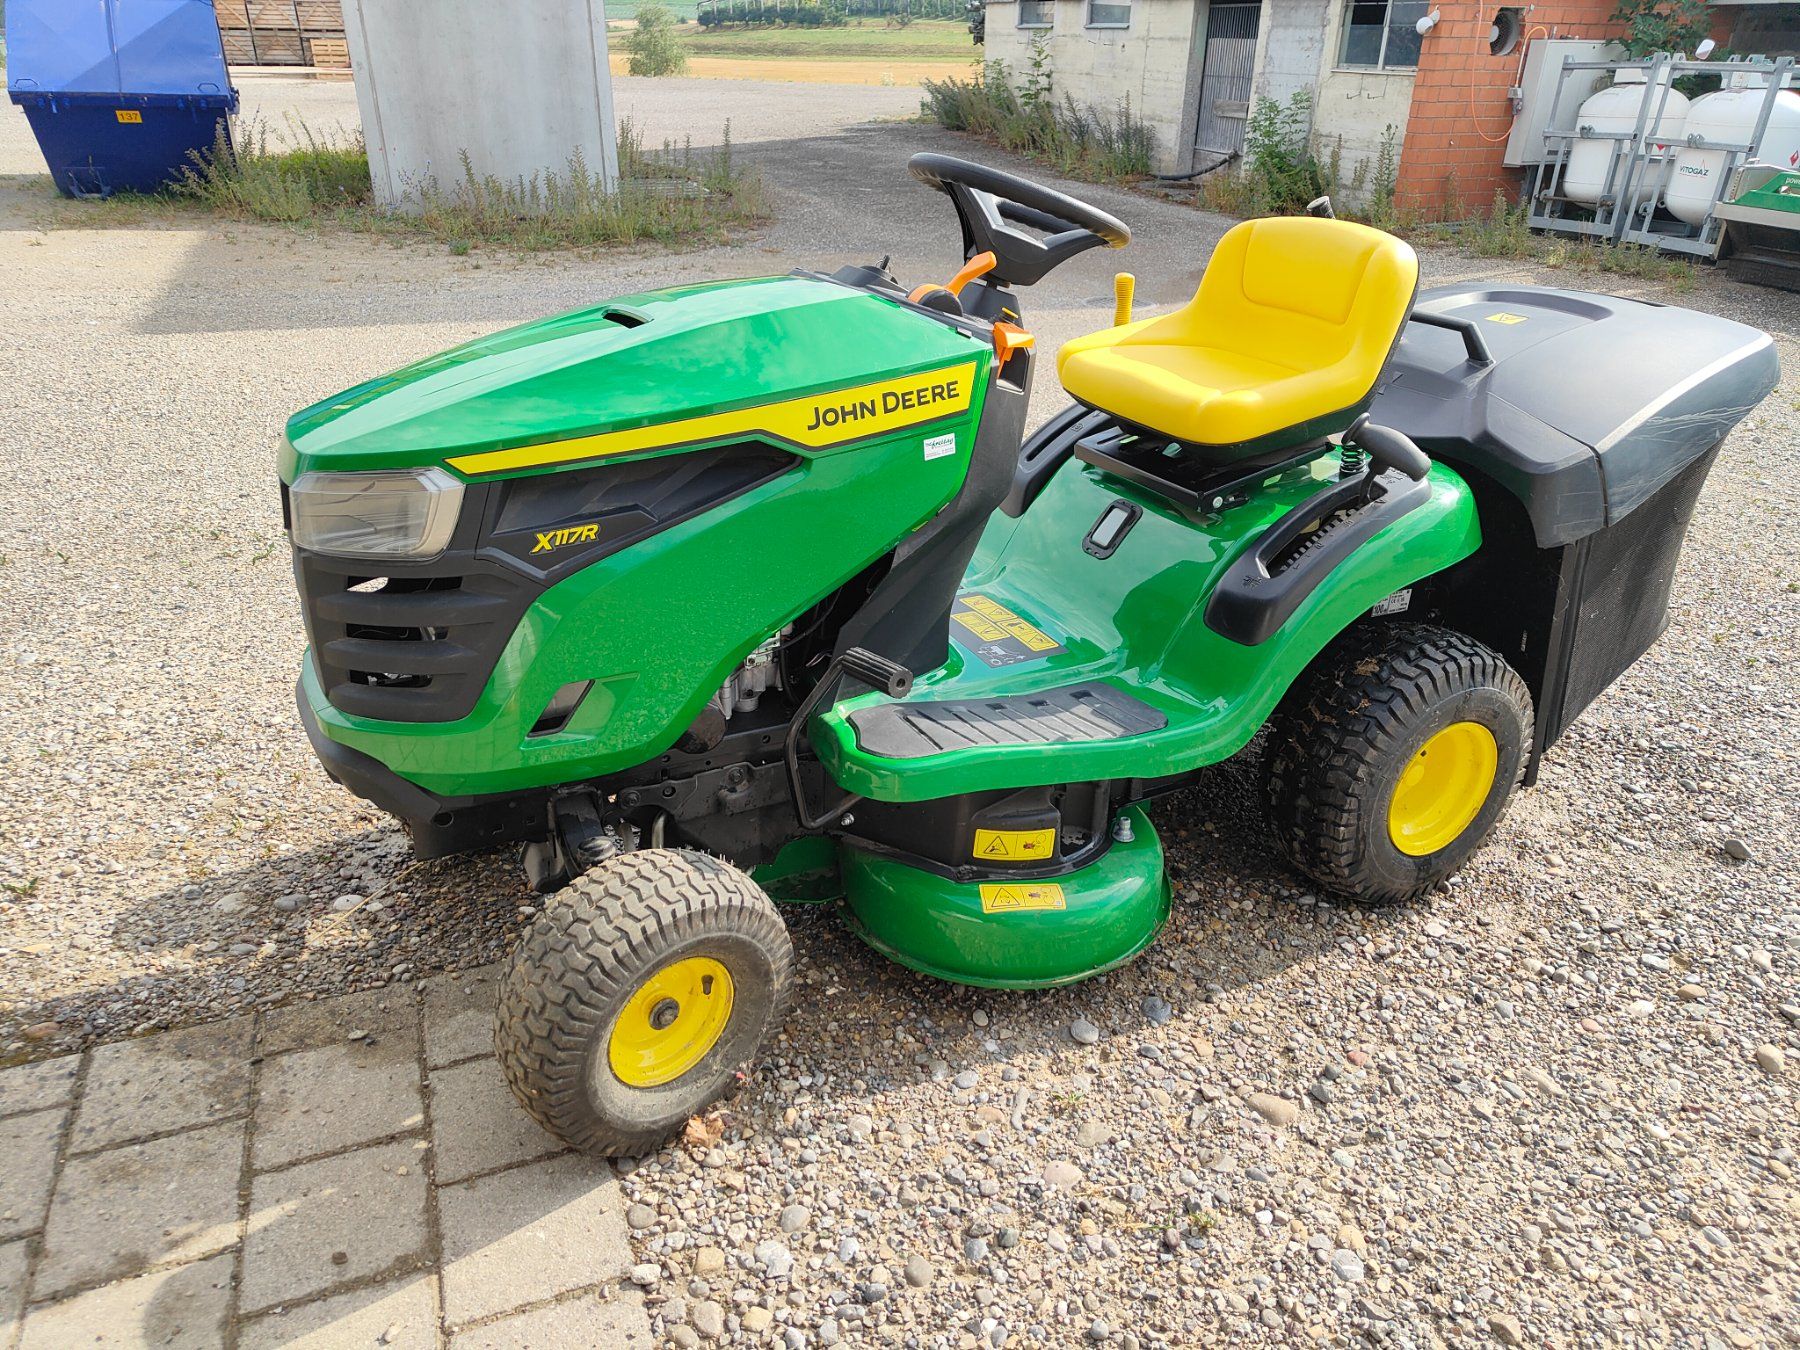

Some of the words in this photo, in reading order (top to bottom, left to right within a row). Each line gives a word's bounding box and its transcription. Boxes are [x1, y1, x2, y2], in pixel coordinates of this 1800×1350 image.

[119, 112, 139, 121] 137
[1680, 165, 1709, 176] VITOGAZ
[807, 399, 877, 431] JOHN
[881, 380, 960, 415] DEERE
[530, 523, 599, 553] X117R
